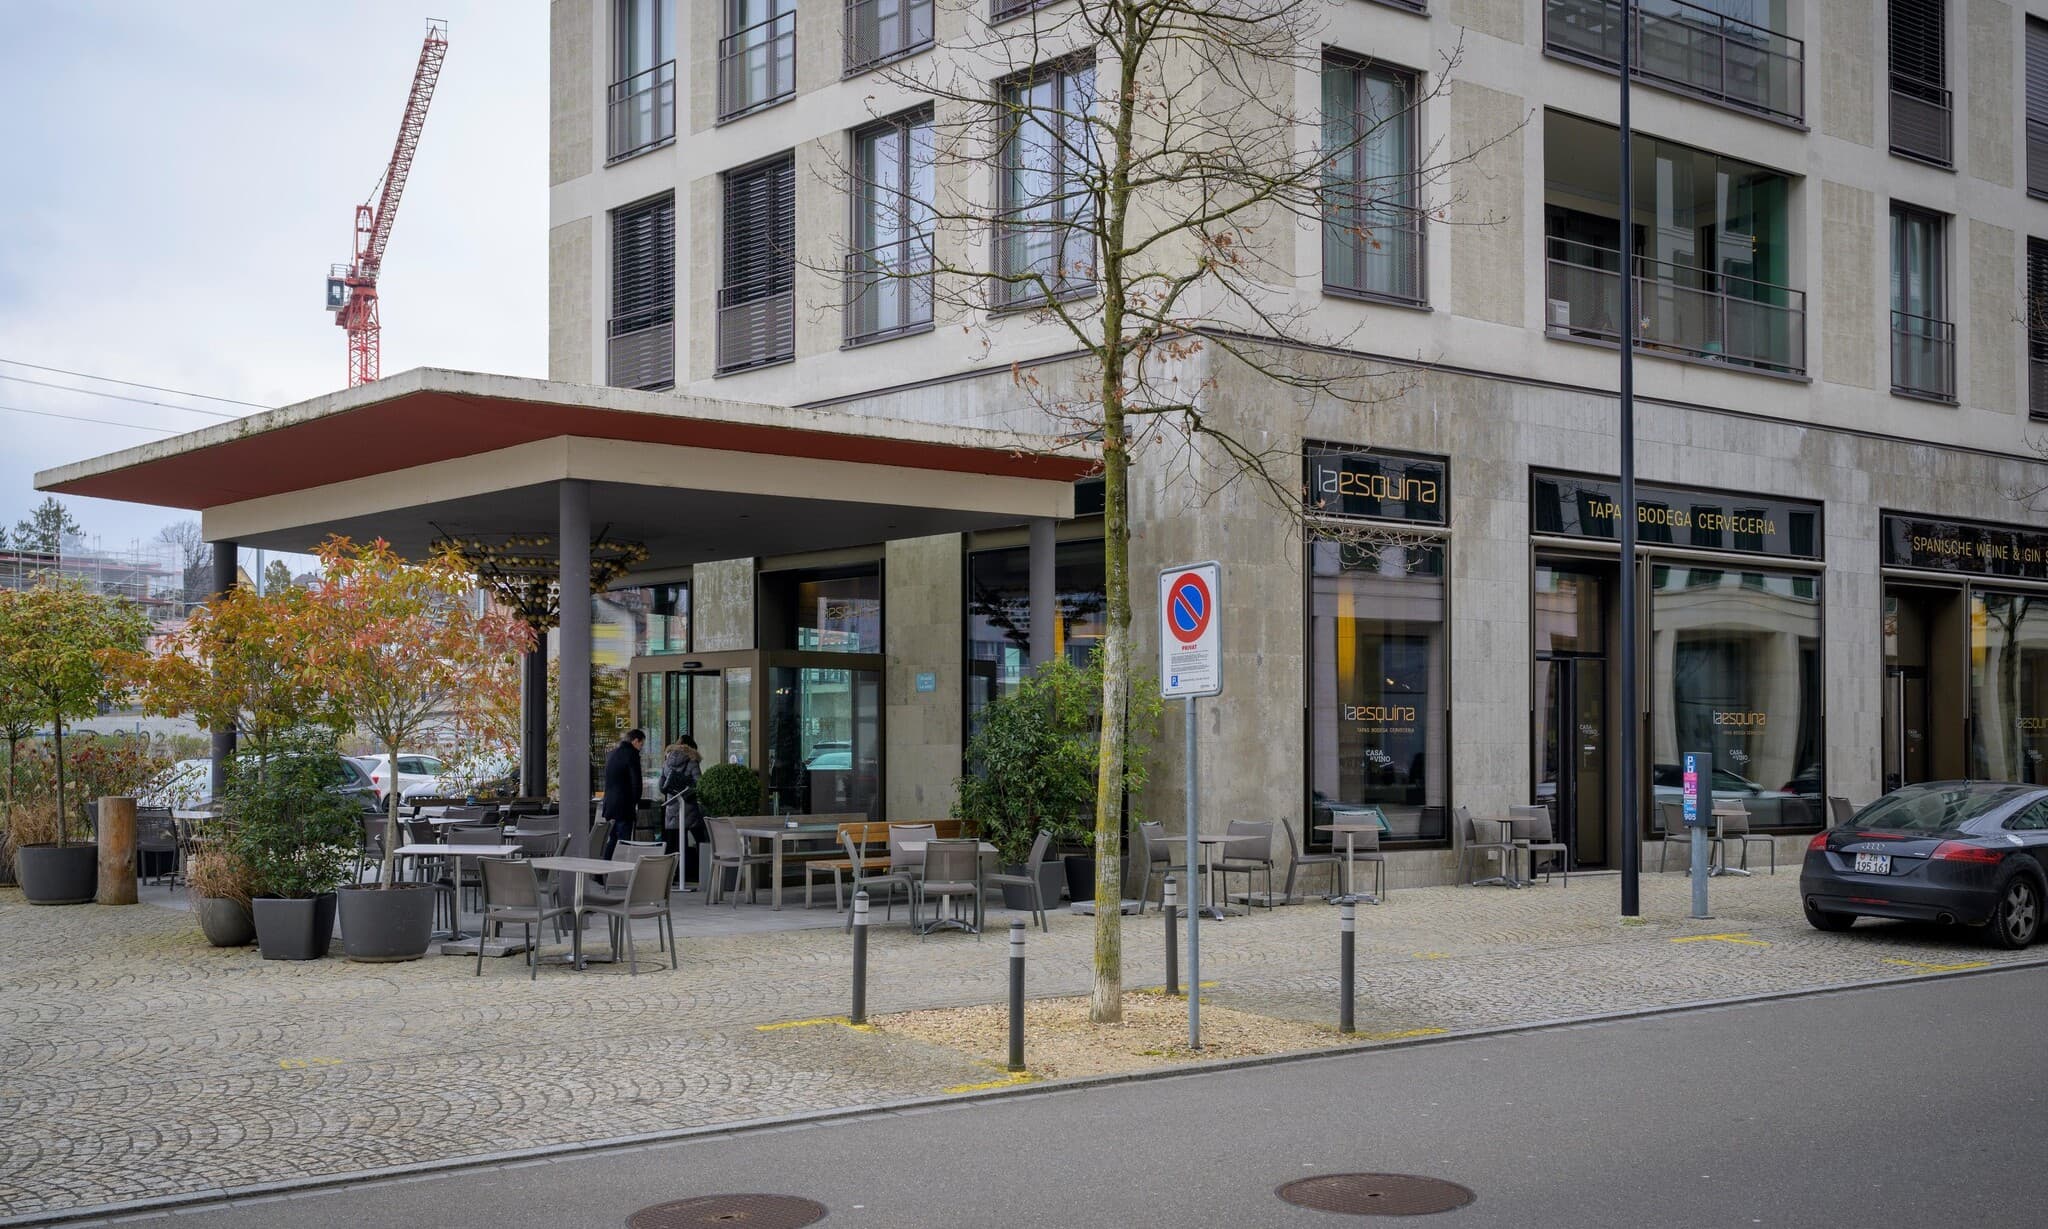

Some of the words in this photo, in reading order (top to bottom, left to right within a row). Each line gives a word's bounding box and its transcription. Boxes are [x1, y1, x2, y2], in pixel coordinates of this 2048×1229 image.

[1318, 464, 1436, 504] laesquina
[1588, 500, 1621, 520] TAPA
[1638, 508, 1693, 528] BODEGA
[1698, 513, 1776, 535] CERVECERIA
[1913, 536, 1972, 557] SPANISCHE
[1976, 543, 2009, 560] WEINE
[2013, 547, 2020, 561] &
[2024, 548, 2041, 563] GIN
[1344, 703, 1415, 723] laesquina
[1856, 862, 1871, 871] 195
[1874, 863, 1889, 872] 161
